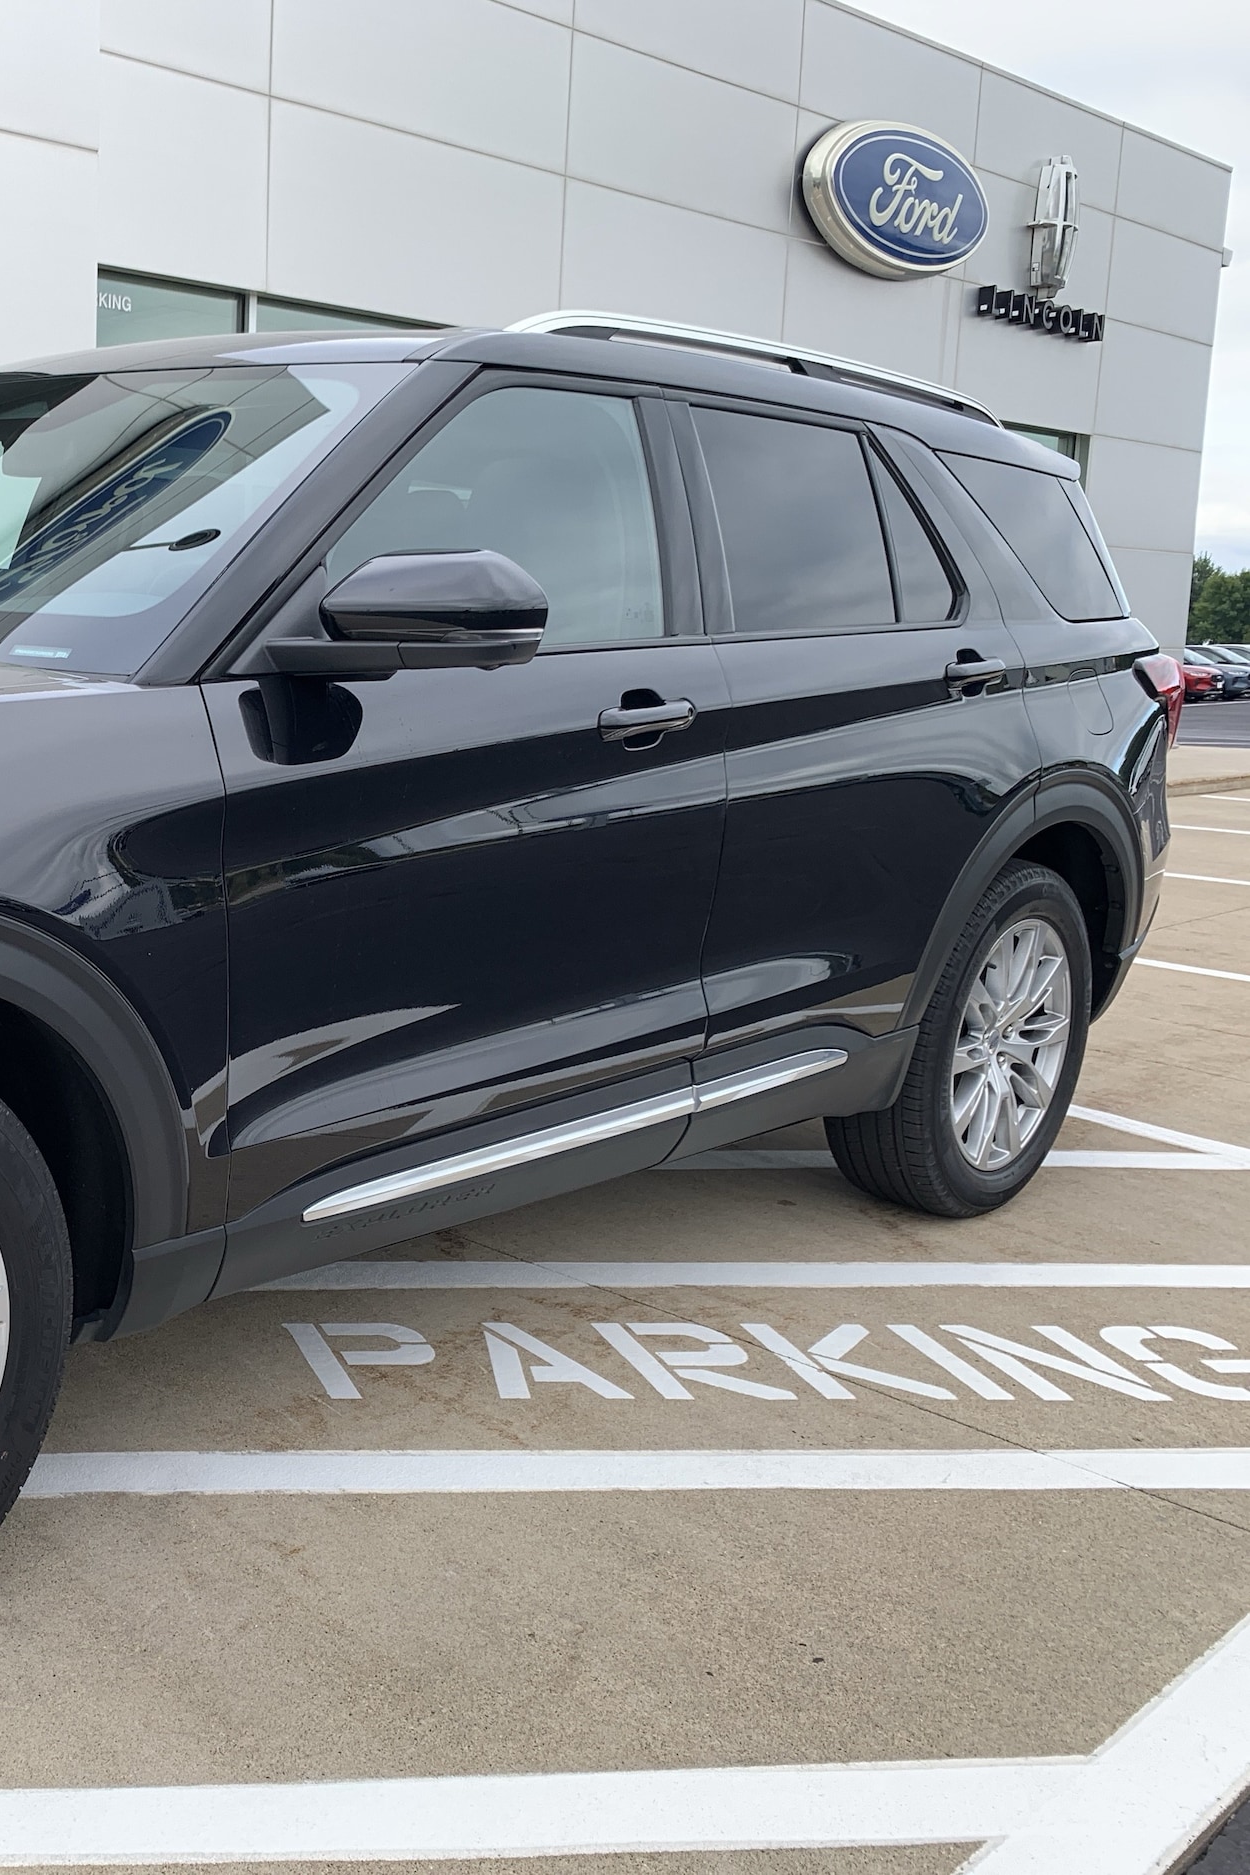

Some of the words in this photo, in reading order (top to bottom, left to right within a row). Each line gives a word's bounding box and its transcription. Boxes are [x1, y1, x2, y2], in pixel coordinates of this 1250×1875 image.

[869, 152, 963, 245] Ford
[96, 291, 132, 312] KING
[978, 284, 1106, 342] LINCOLN
[281, 1322, 1250, 1401] PARKING
